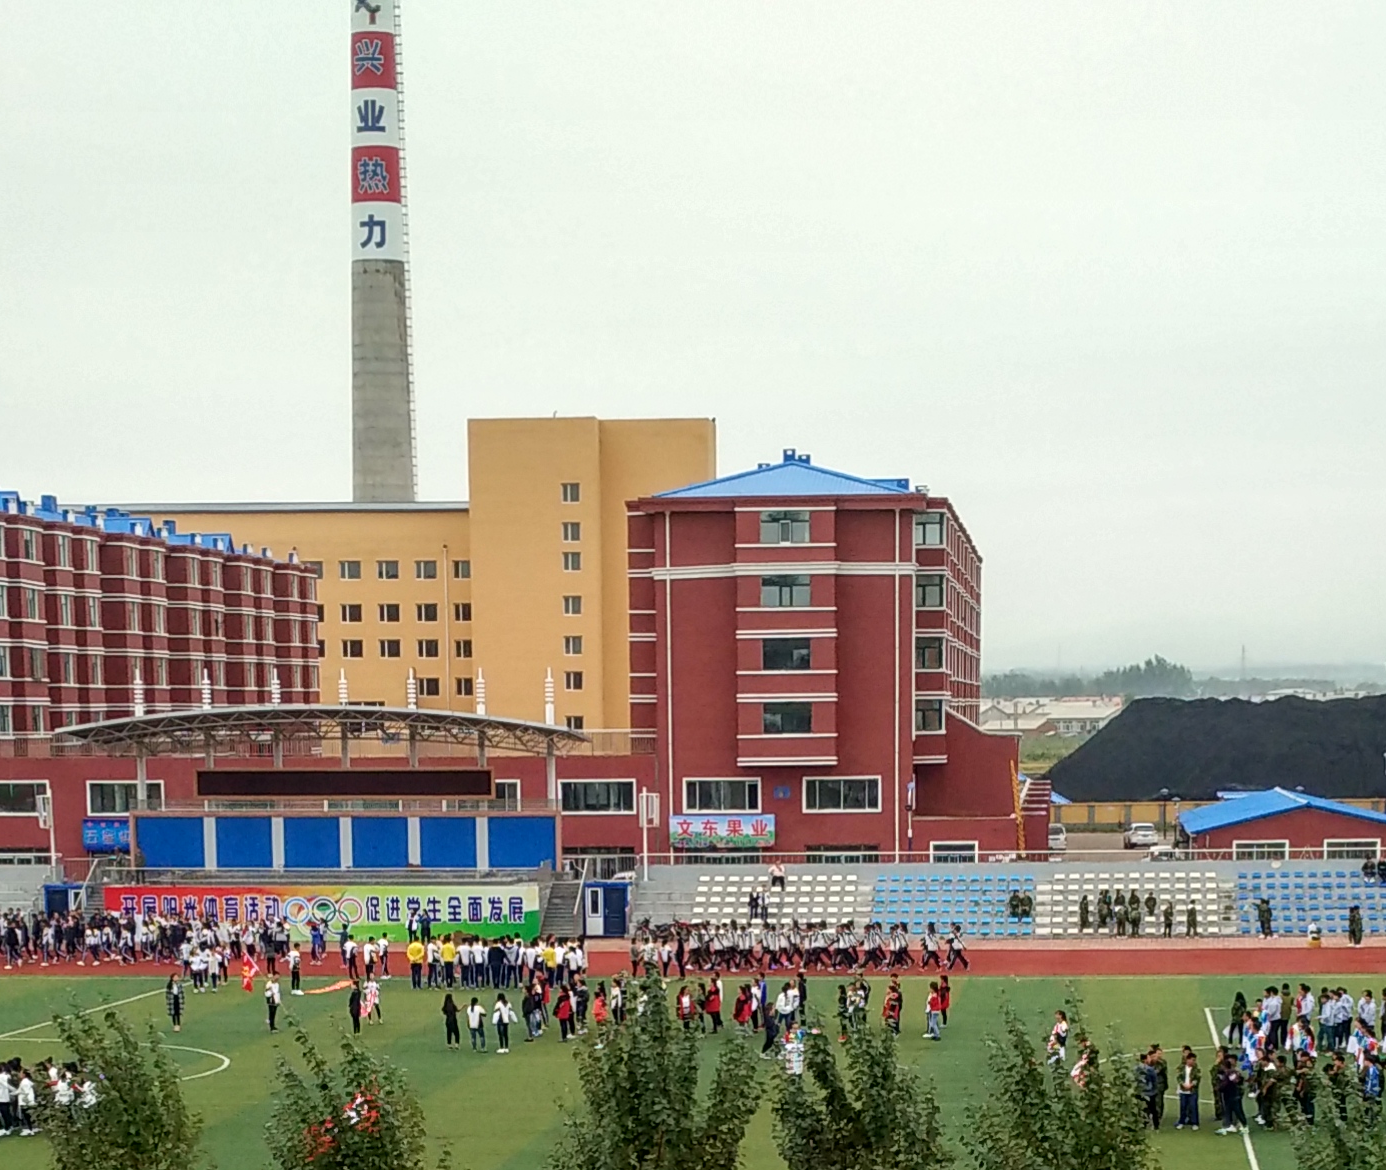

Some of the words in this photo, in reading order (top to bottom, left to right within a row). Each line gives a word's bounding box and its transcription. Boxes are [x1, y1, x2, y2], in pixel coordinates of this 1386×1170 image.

[676, 818, 769, 838] 文东果业
[365, 896, 525, 923] 促进学生全面发展
